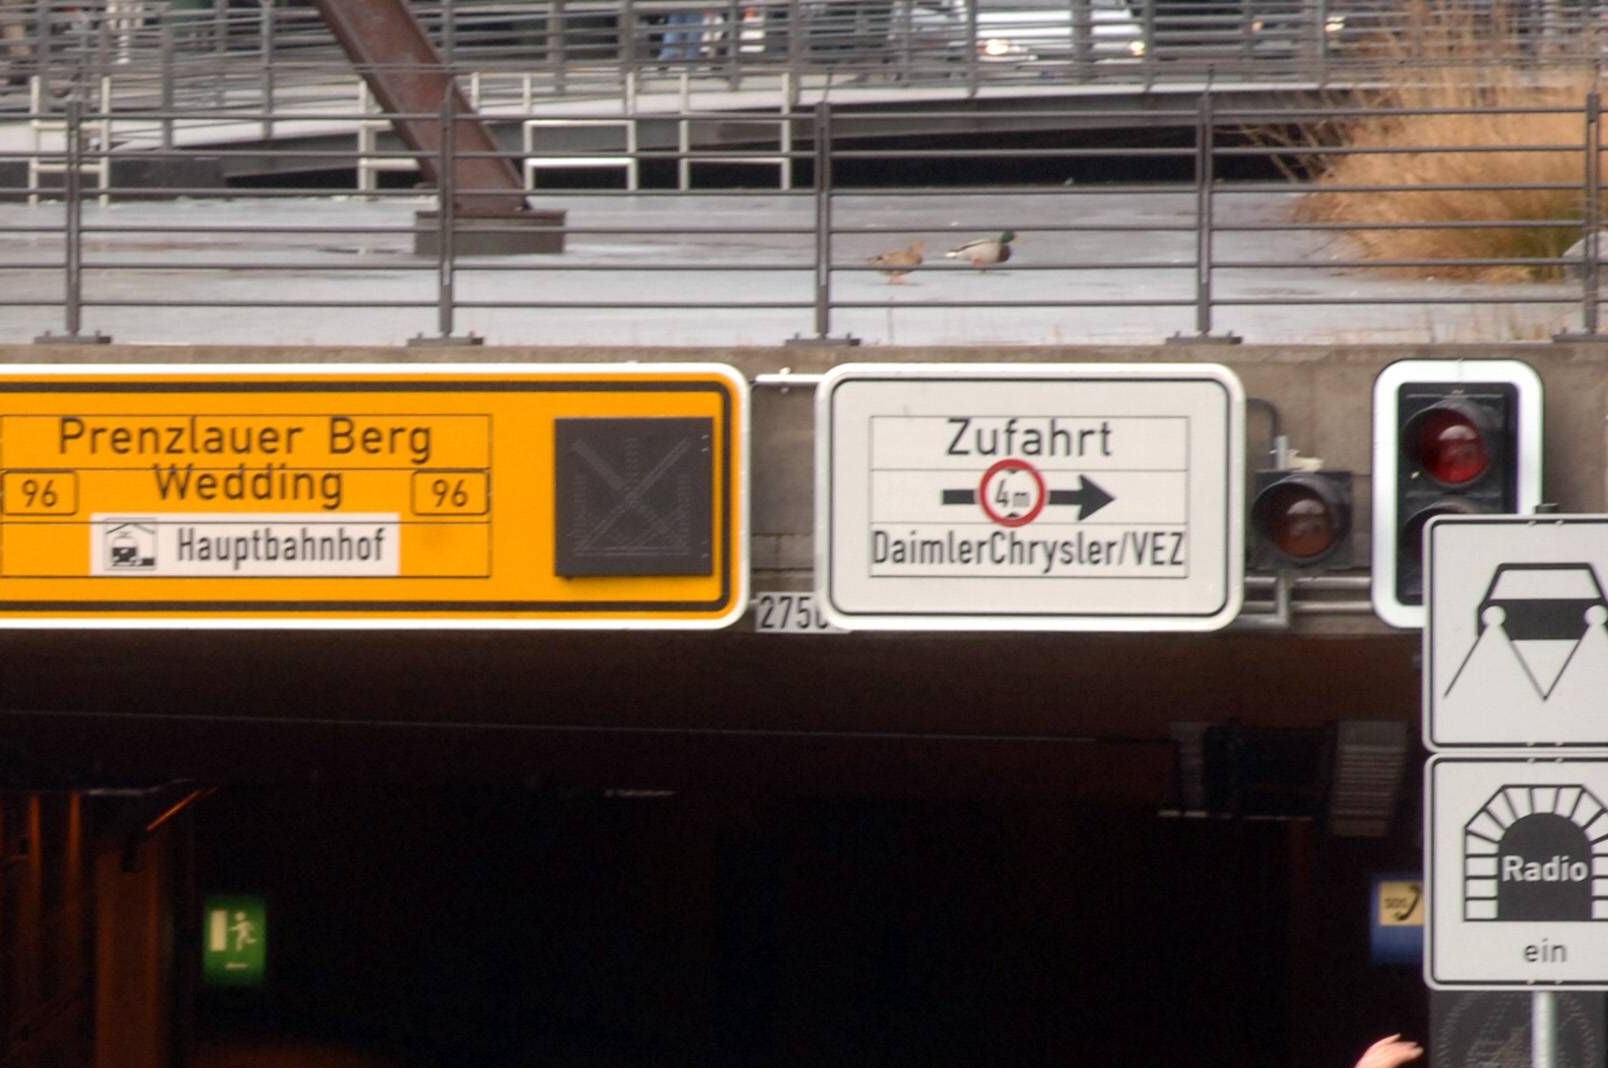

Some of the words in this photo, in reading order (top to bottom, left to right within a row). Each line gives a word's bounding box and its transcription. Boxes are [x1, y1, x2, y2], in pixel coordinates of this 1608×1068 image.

[58, 417, 304, 455] Prenzlauer
[328, 417, 433, 465] Berg
[946, 418, 1114, 456] Zufahrt
[20, 479, 59, 507] 96
[152, 464, 344, 510] Wedding
[431, 479, 469, 507] 96
[176, 528, 386, 570] Hauptbahnhof
[872, 530, 1185, 574] DaimlerChrysler/VEZ
[1500, 854, 1589, 882] Radio
[1522, 938, 1568, 963] ein
